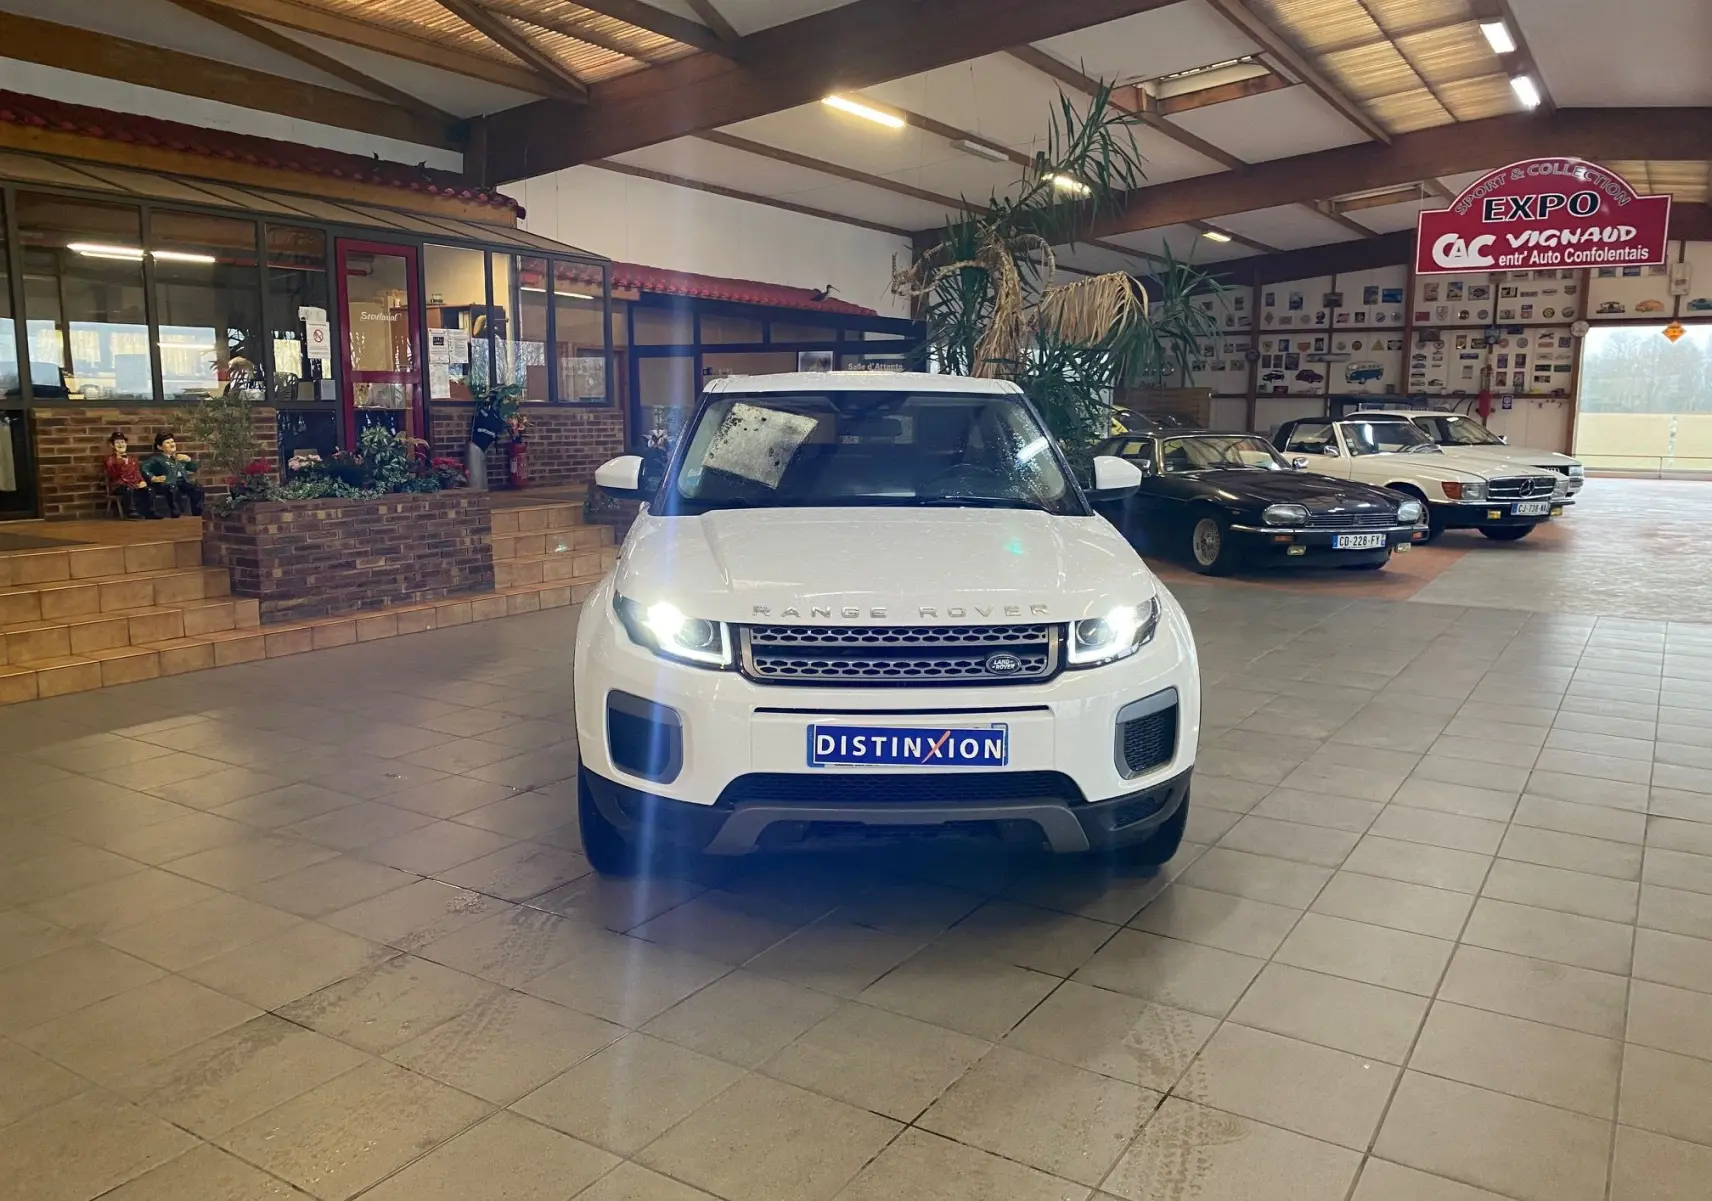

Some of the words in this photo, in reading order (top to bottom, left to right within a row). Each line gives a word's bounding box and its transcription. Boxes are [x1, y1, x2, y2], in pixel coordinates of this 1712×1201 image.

[1455, 173, 1506, 216] SPORT
[1510, 167, 1526, 181] &
[1527, 163, 1631, 207] COLLECTION
[1482, 190, 1601, 223] EXPO
[1432, 232, 1497, 268] CAC
[1506, 225, 1637, 248] VIGNAUD
[1529, 249, 1561, 264] Auto
[1563, 245, 1649, 263] Confolentais
[1339, 535, 1381, 547] CD-228-FY
[752, 605, 888, 619] RANGE
[918, 603, 1050, 618] ROVER
[816, 731, 1002, 763] DISTINXION
